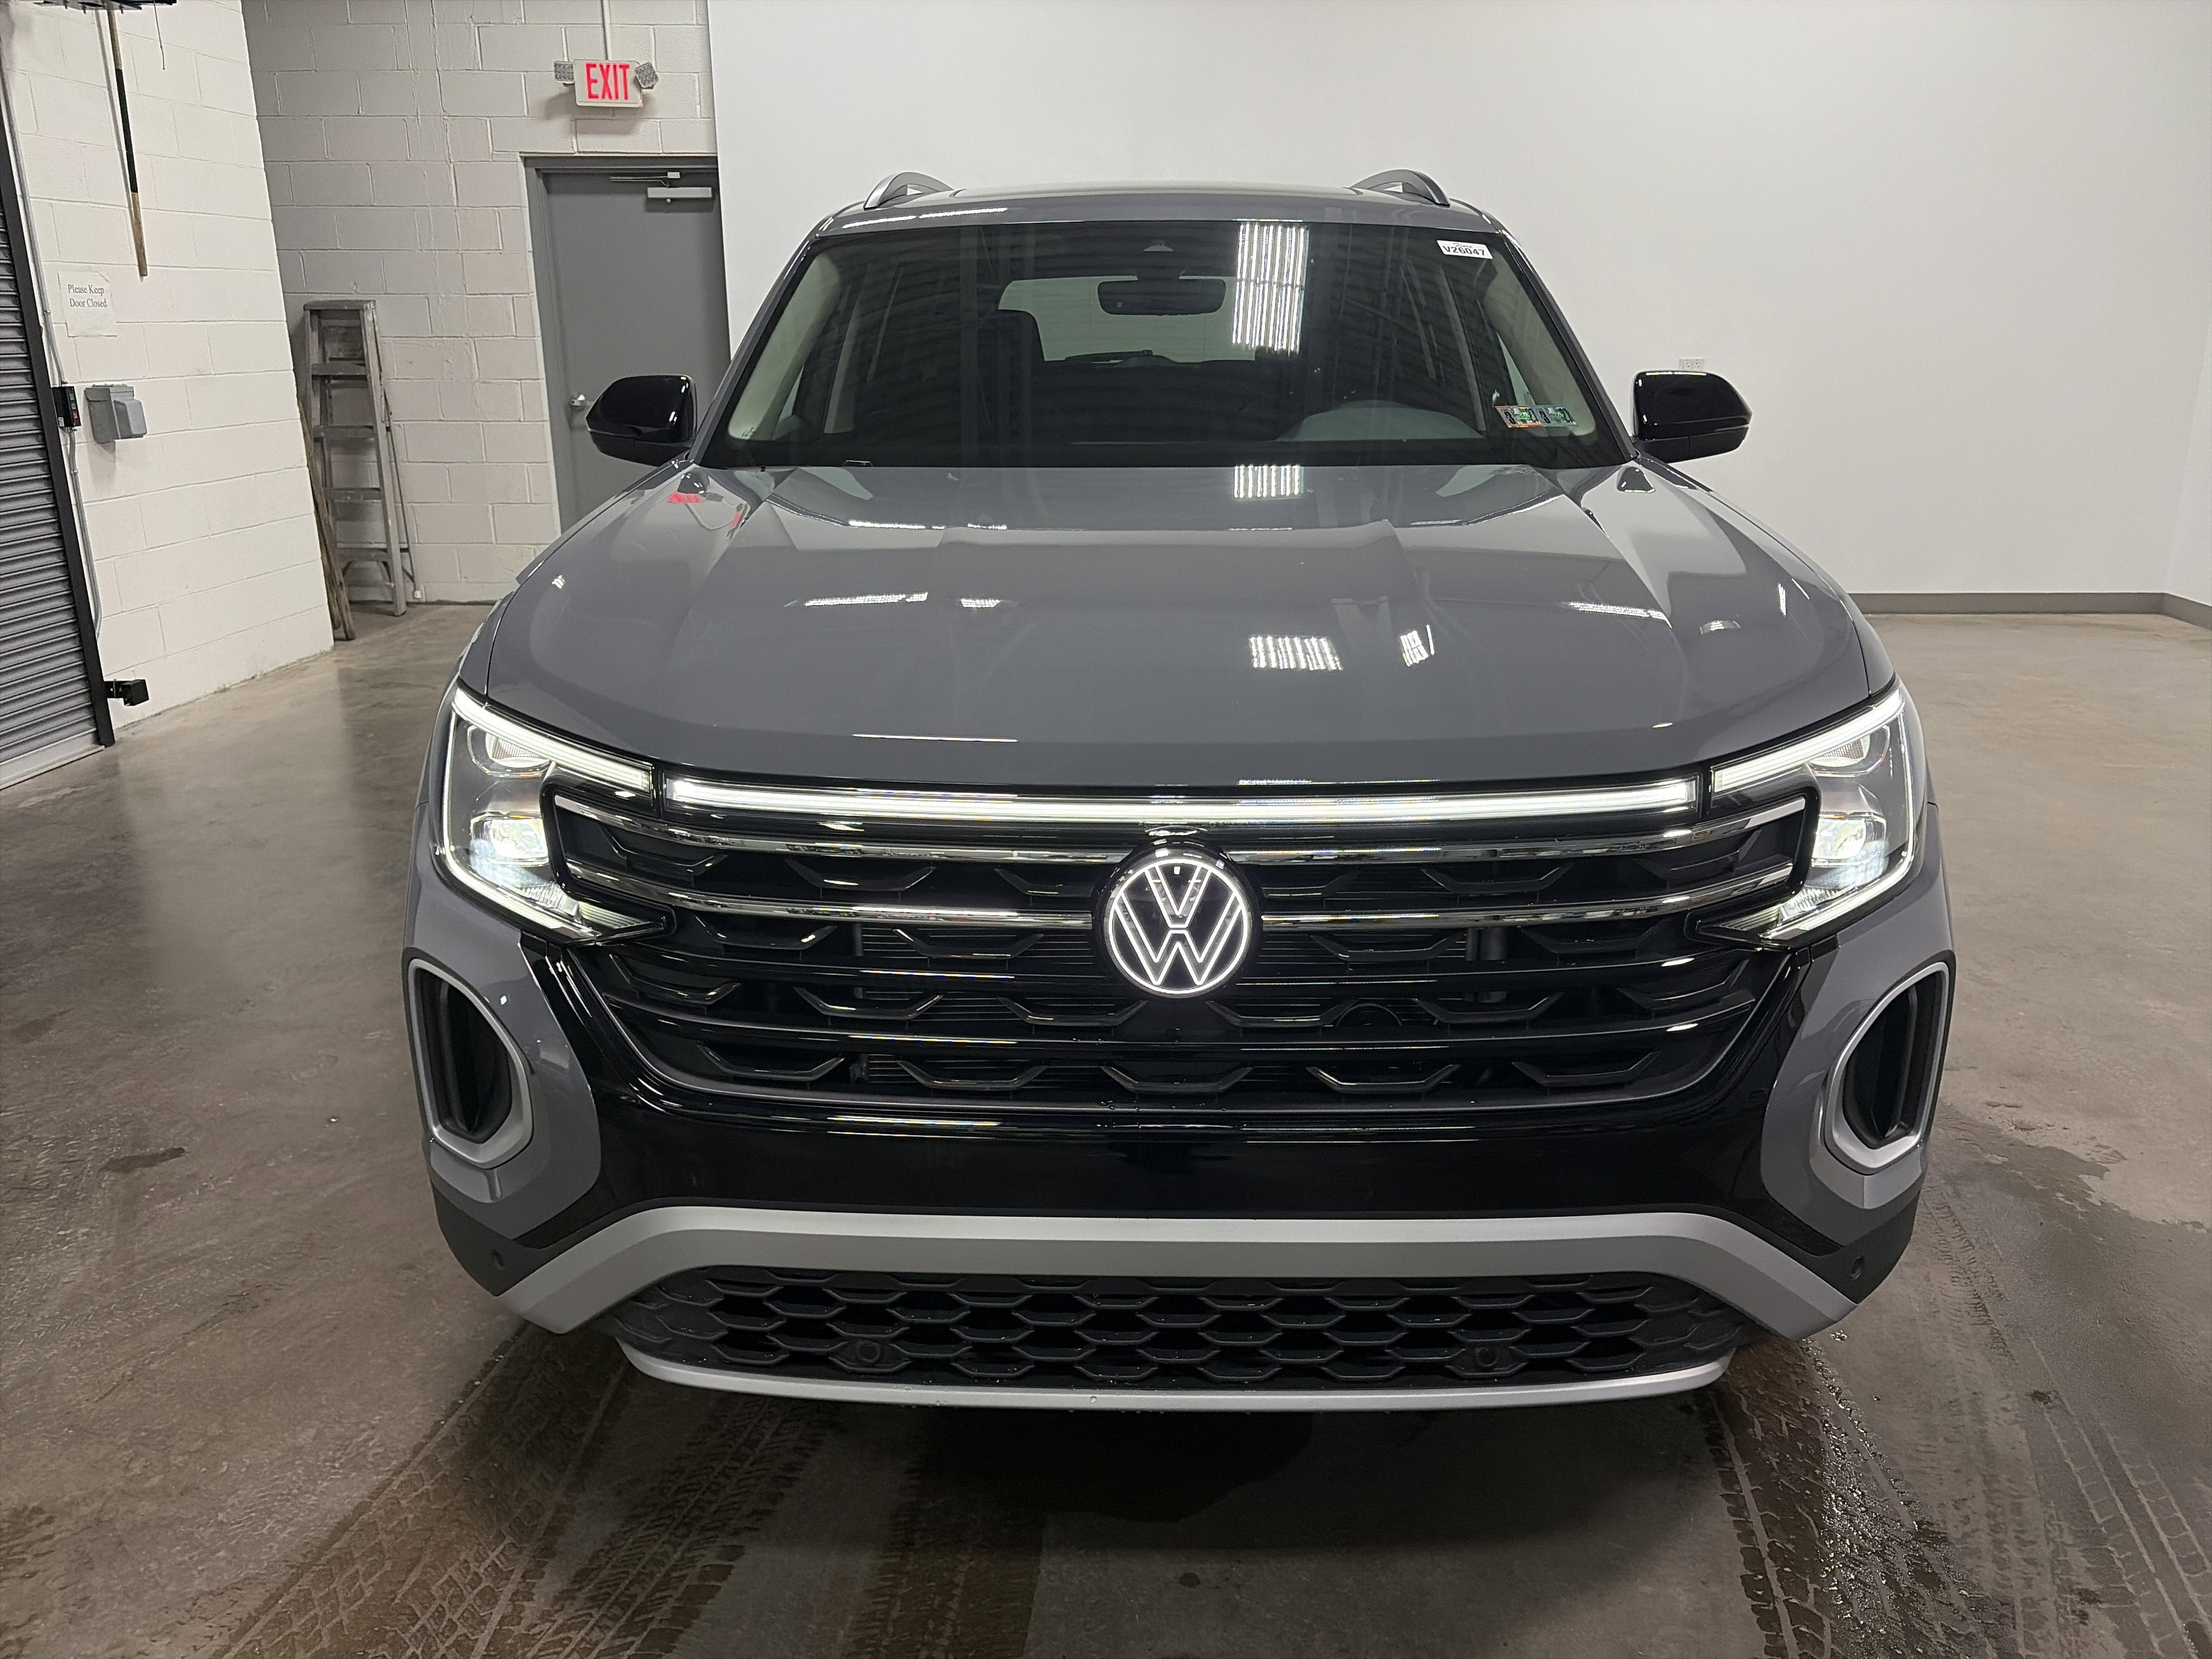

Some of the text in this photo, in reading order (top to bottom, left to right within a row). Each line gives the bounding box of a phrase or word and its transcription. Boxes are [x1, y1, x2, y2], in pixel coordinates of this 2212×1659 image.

[585, 62, 630, 100] EXIT
[1442, 245, 1485, 256] V26047
[67, 284, 104, 296] Please Keep
[69, 298, 108, 308] Door Closed
[1504, 411, 1516, 424] 3
[1539, 410, 1551, 424] 3
